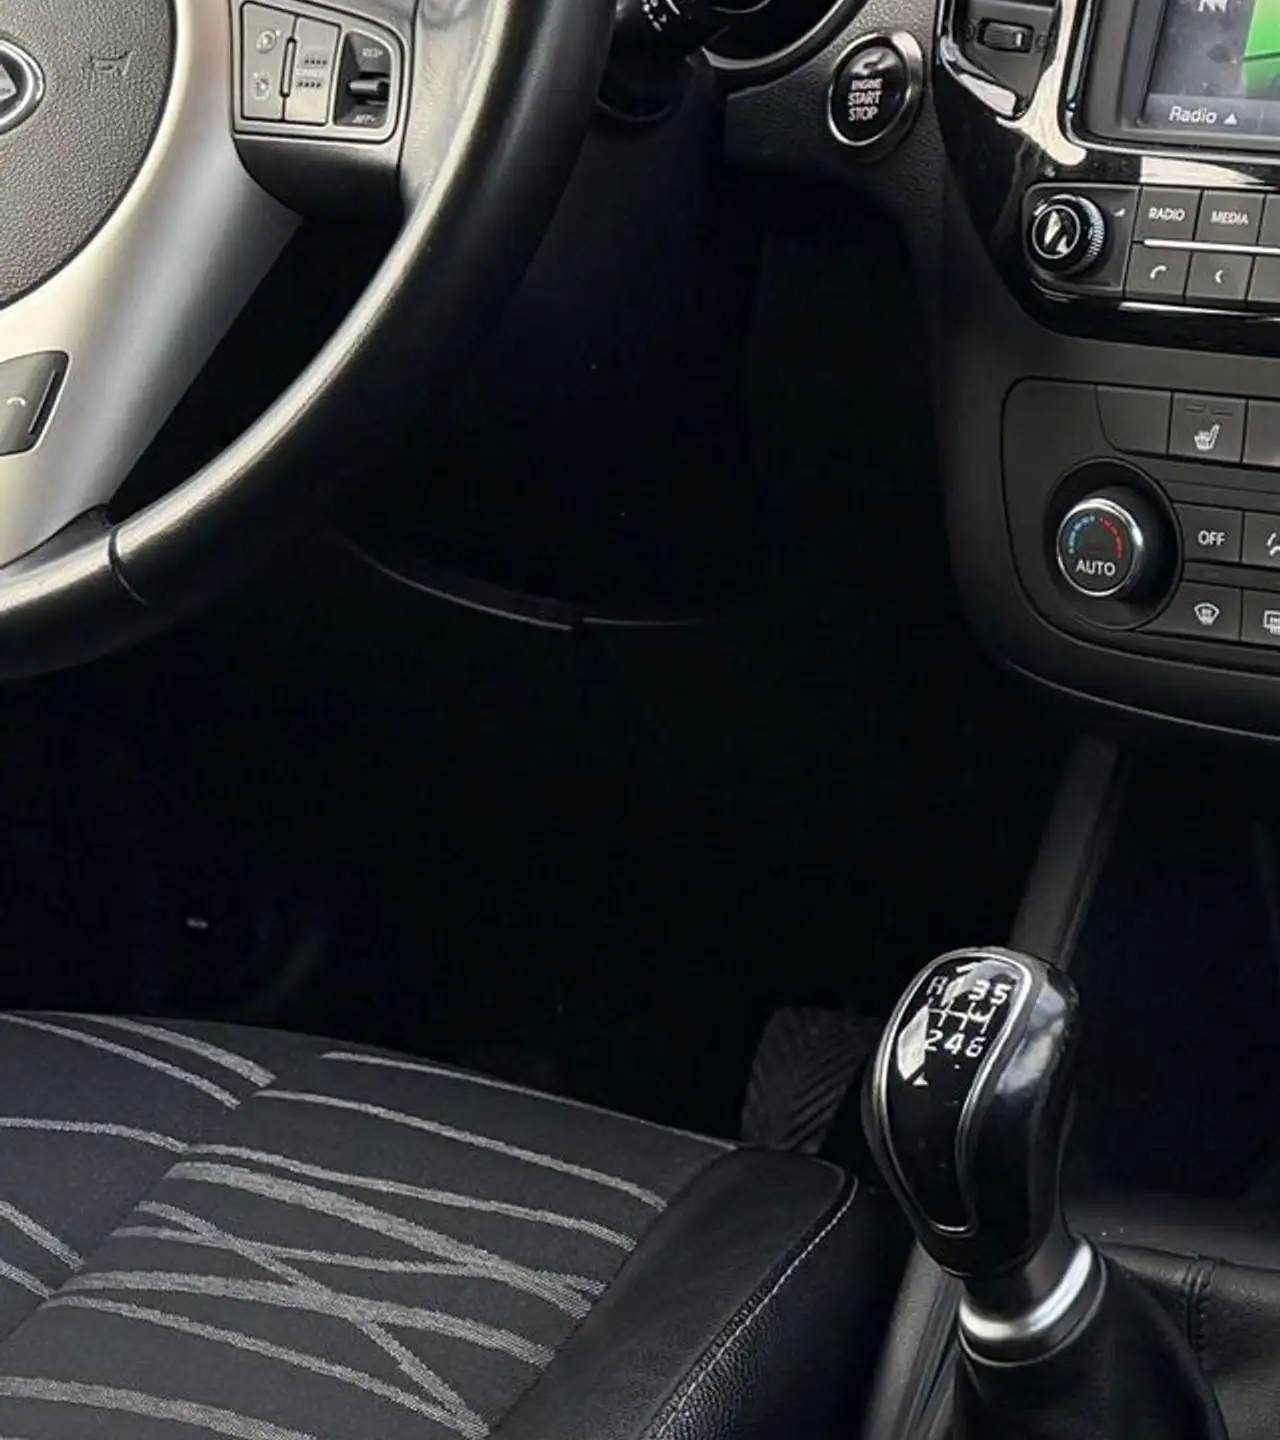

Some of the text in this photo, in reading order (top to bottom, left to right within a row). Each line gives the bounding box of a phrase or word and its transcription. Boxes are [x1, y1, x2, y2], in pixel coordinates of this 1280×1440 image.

[847, 90, 882, 106] START
[847, 106, 878, 122] STOP
[1169, 105, 1217, 125] Radio
[1148, 206, 1185, 222] RADIO
[1211, 210, 1249, 226] MEDIA
[1198, 529, 1226, 546] OFF
[1076, 559, 1116, 577] AUTO
[968, 980, 991, 1000] 3
[990, 983, 1012, 1005] 5
[924, 1029, 987, 1058] 2 4 6
